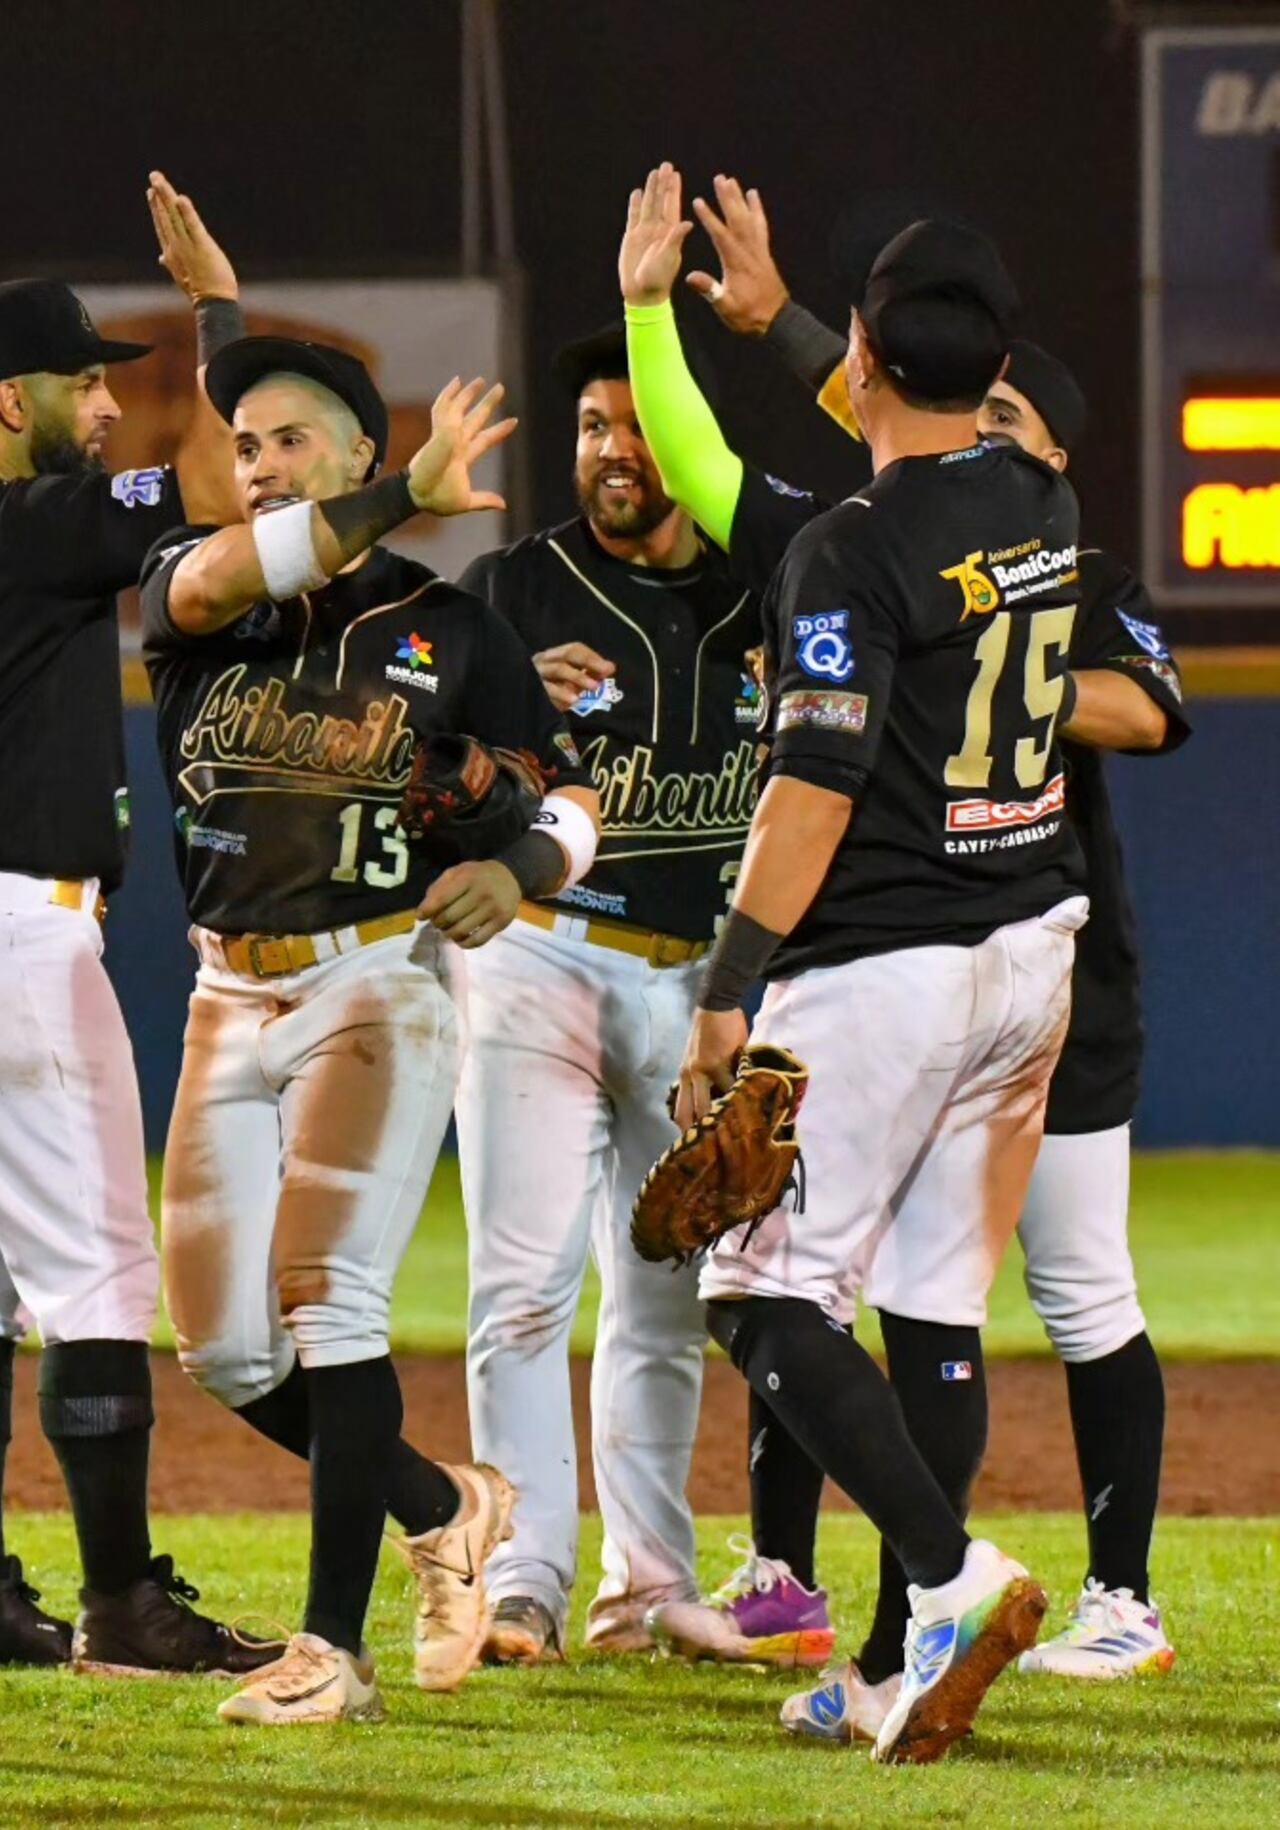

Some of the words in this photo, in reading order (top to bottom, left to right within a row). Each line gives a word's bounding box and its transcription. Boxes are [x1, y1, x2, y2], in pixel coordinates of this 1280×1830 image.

[988, 538, 1041, 564] Aniversario
[796, 613, 847, 635] DON
[800, 631, 855, 677] Q
[943, 604, 1078, 789] 15
[331, 802, 410, 890] 13
